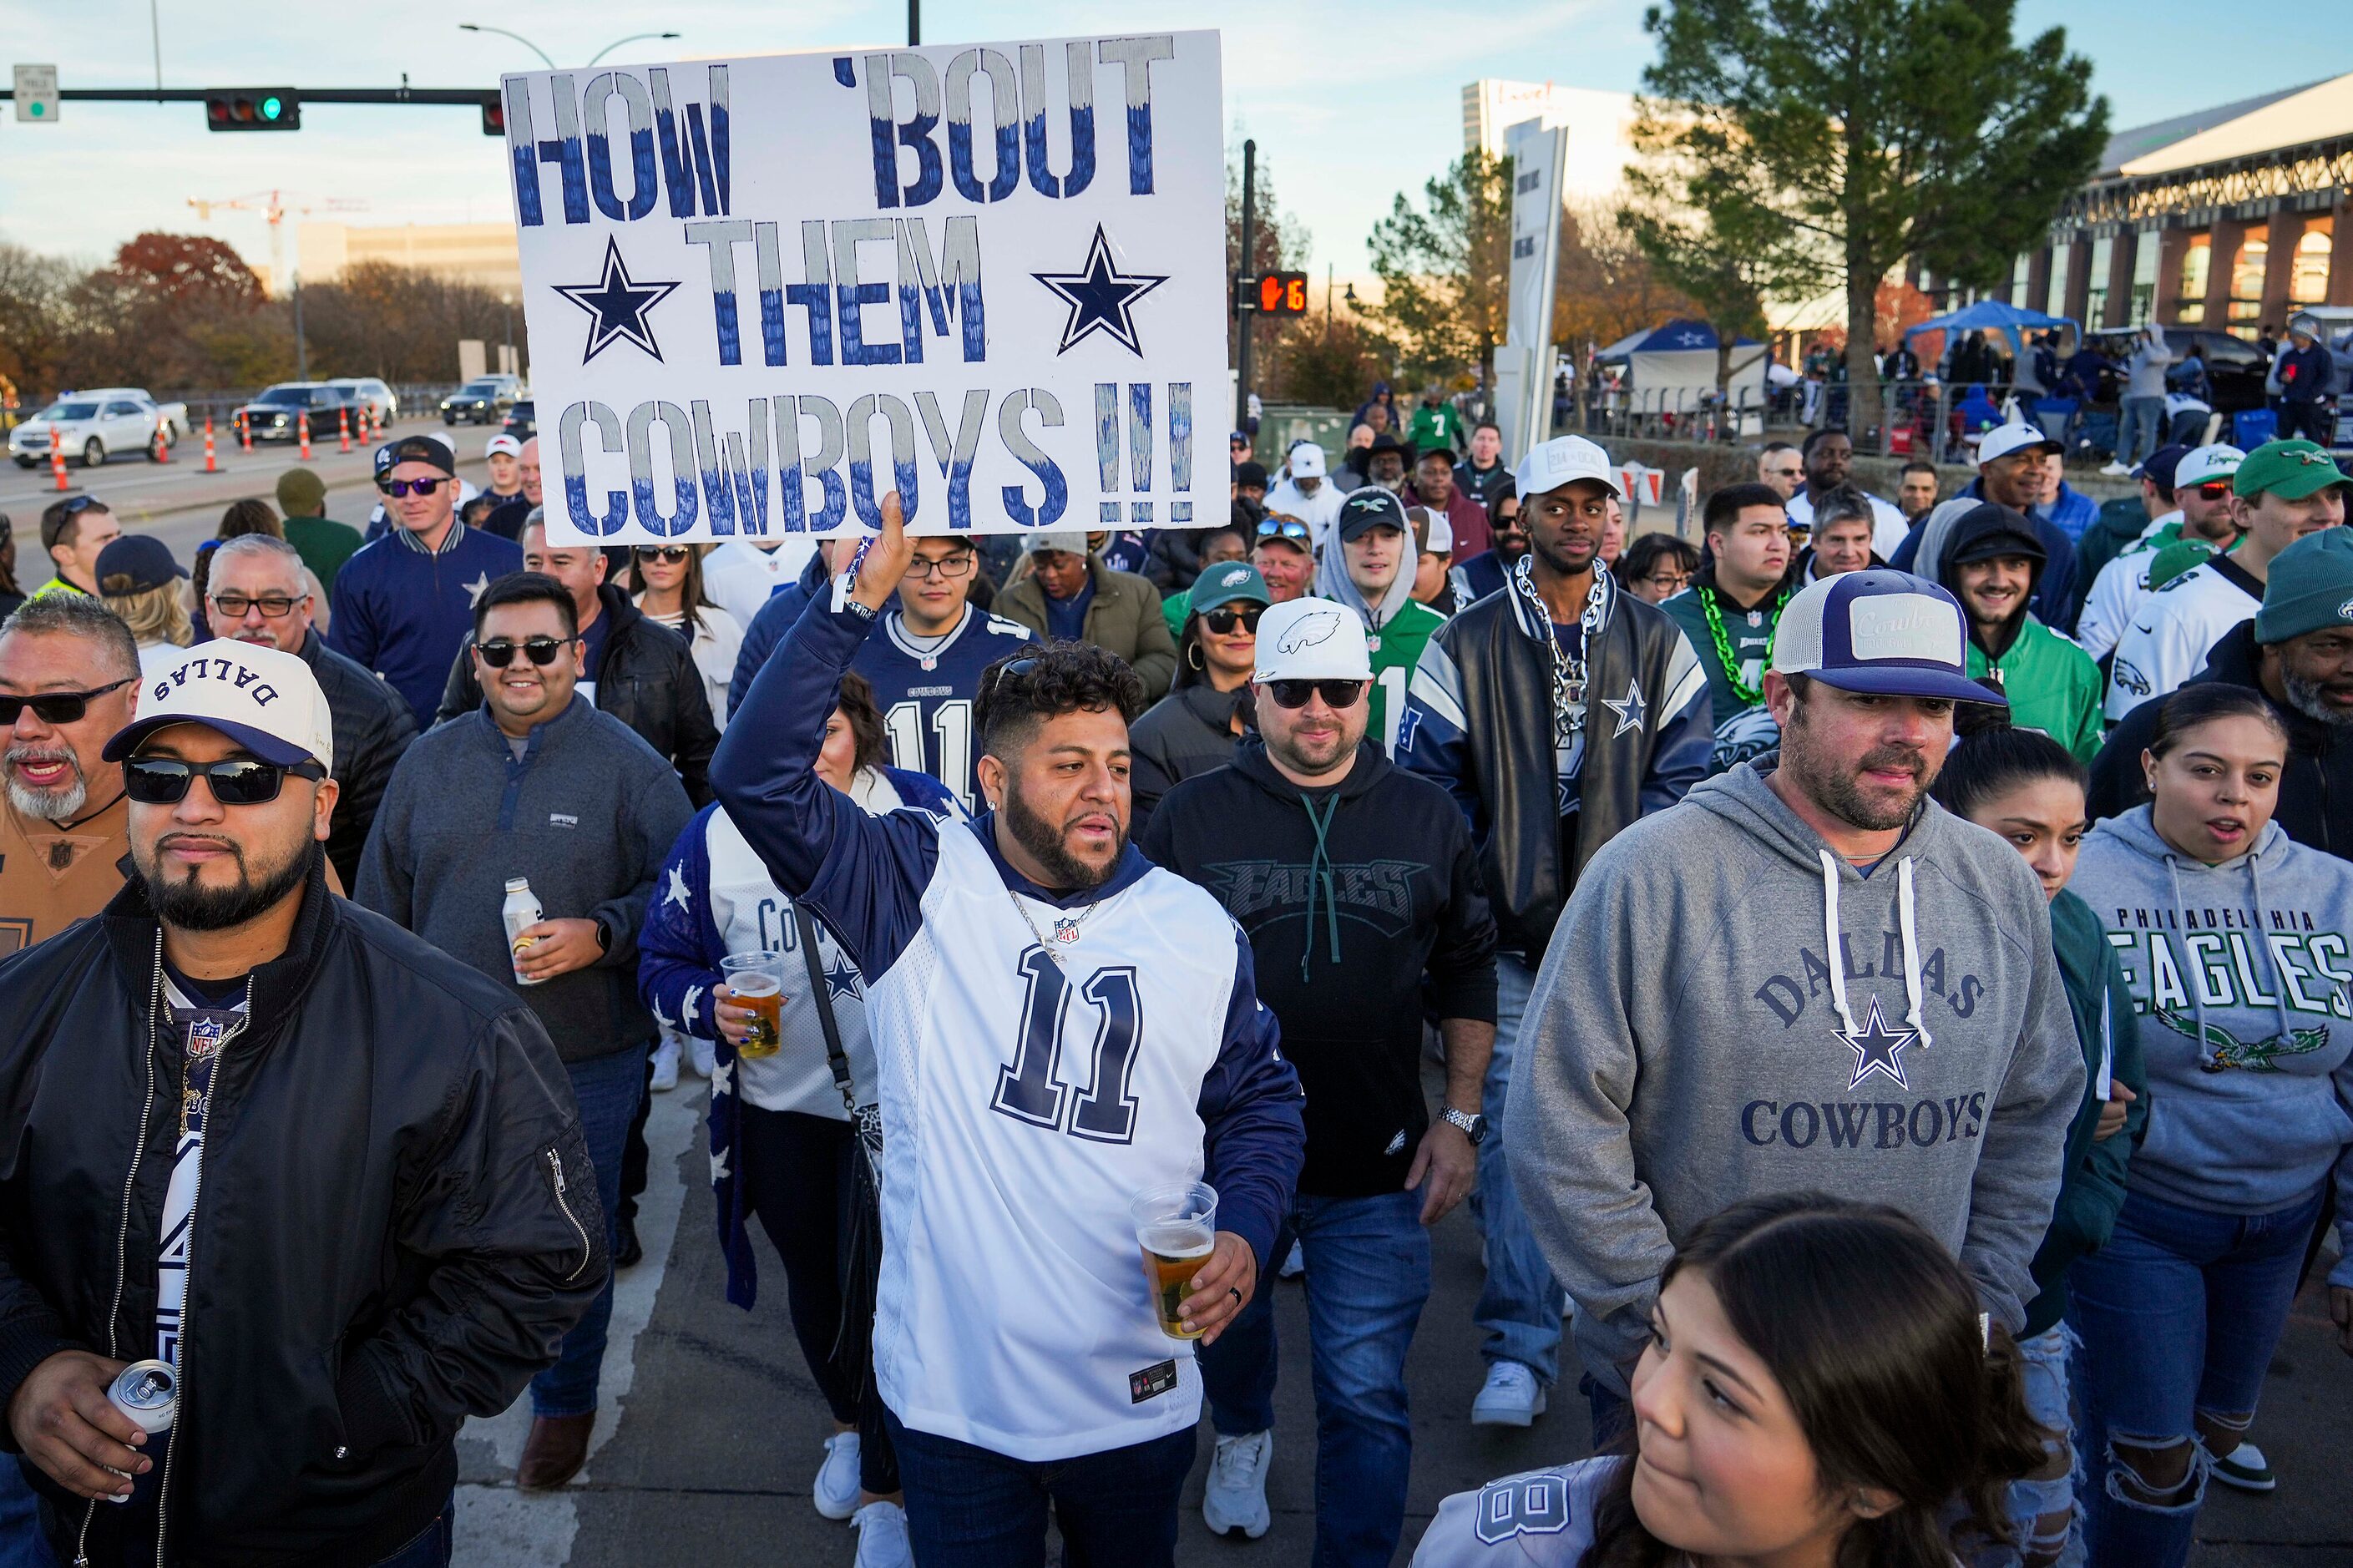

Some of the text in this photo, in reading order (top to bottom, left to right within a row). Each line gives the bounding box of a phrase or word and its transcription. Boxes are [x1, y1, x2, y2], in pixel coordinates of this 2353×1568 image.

[505, 64, 731, 226] HOW
[685, 215, 987, 367] THEM
[1431, 413, 1445, 437] 7
[154, 658, 279, 707] DALLAS
[907, 685, 953, 697] COWBOYS
[883, 699, 976, 818] 11
[1754, 930, 1985, 1029] DALLAS
[191, 1037, 215, 1055] NFL
[989, 943, 1144, 1146] 11
[1741, 1090, 1986, 1149] COWBOYS
[1475, 1474, 1571, 1547] 8
